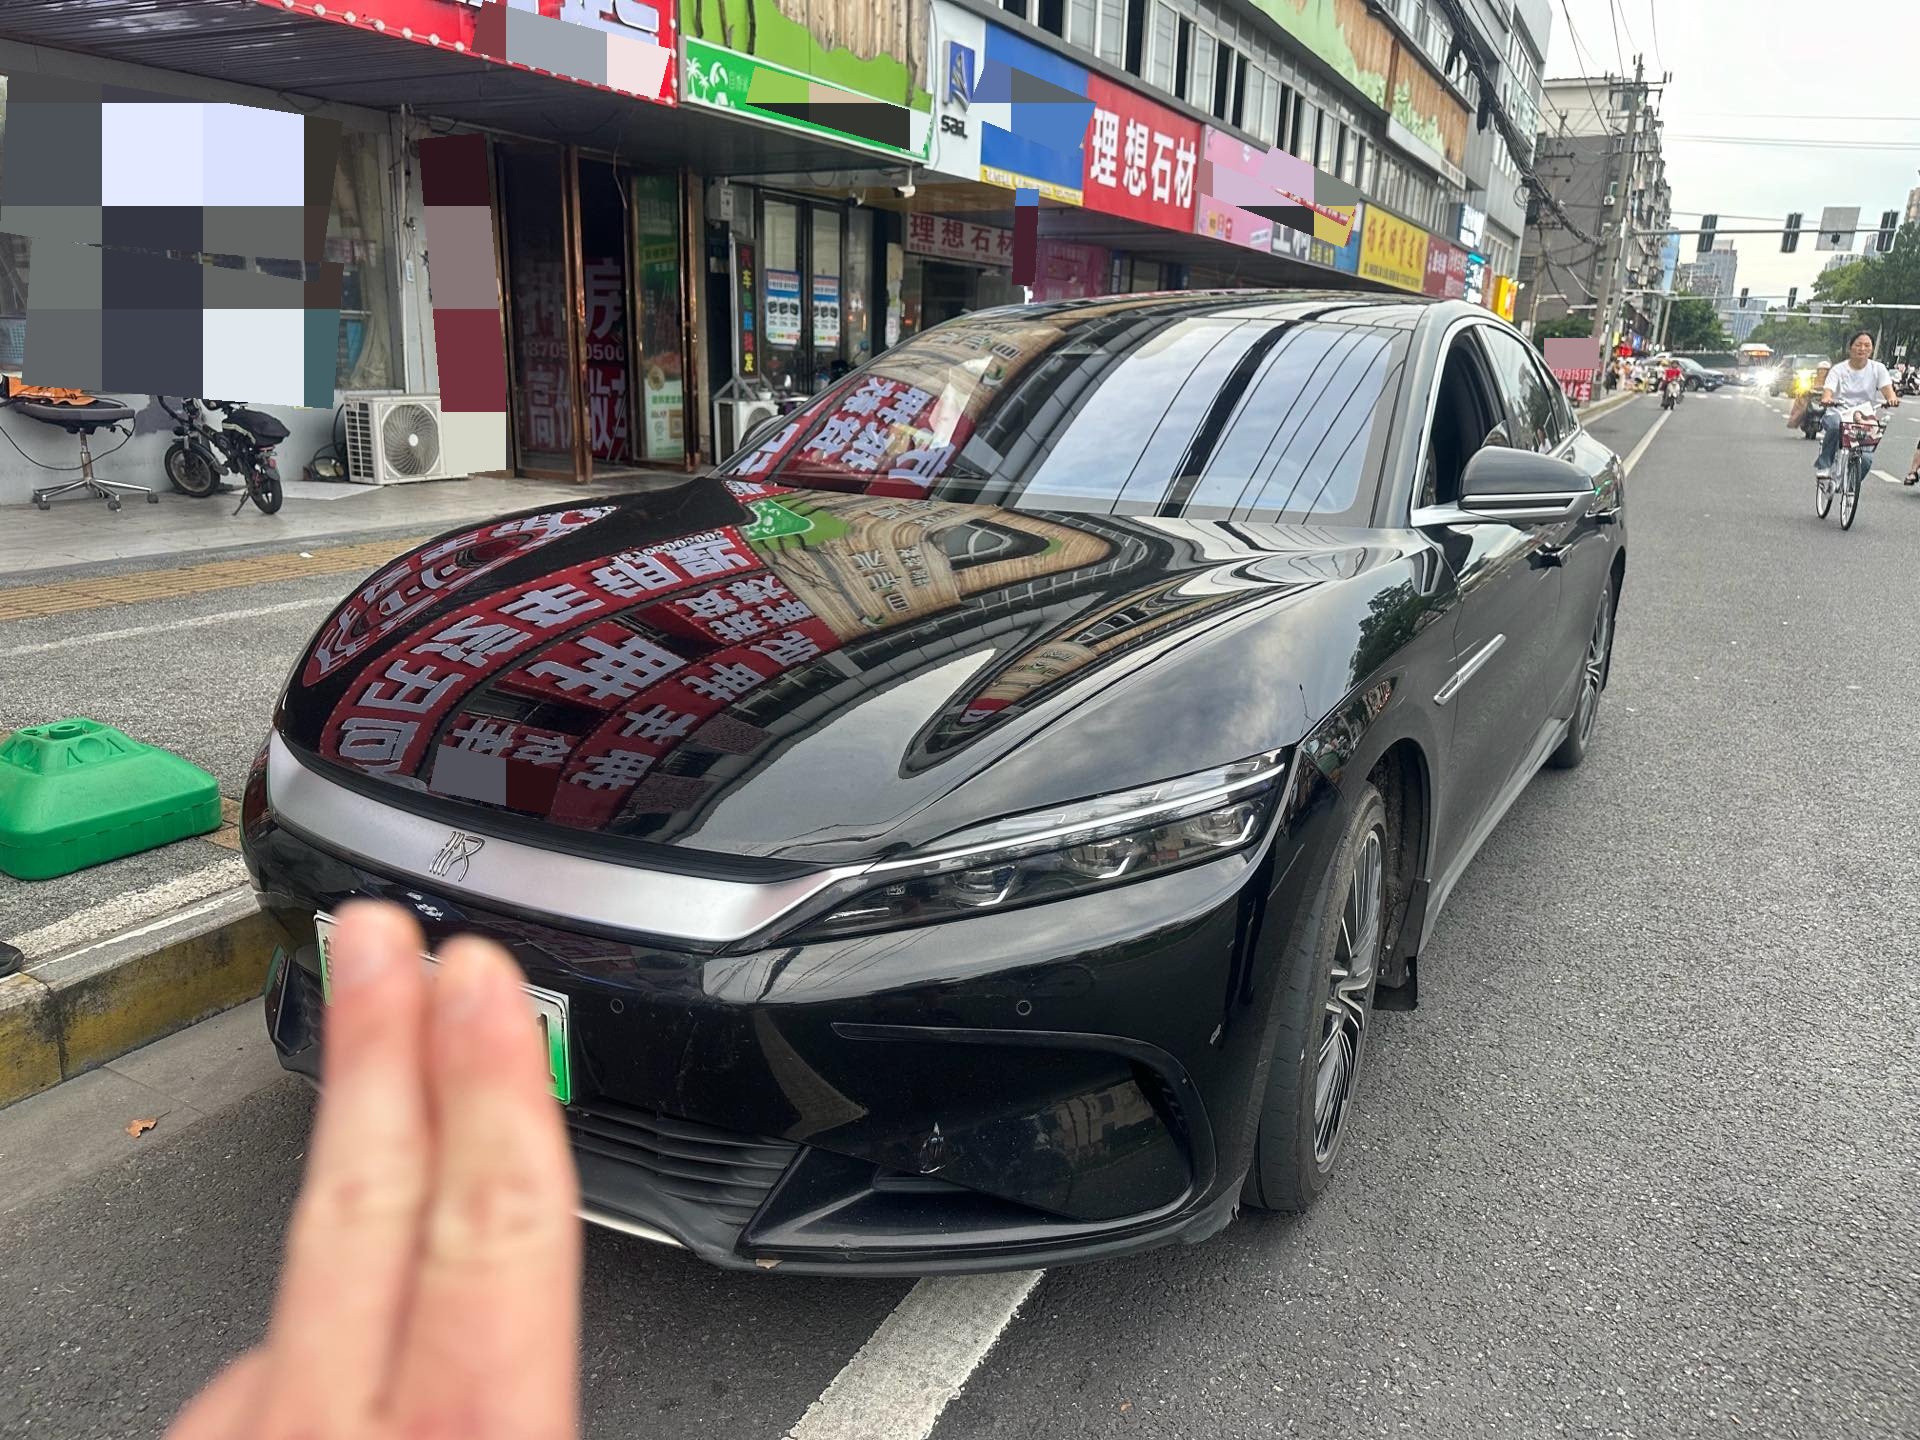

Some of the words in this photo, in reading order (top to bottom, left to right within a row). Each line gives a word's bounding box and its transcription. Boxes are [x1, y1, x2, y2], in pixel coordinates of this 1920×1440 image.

[1090, 106, 1196, 209] 理想石材
[910, 212, 1014, 256] 理想石材
